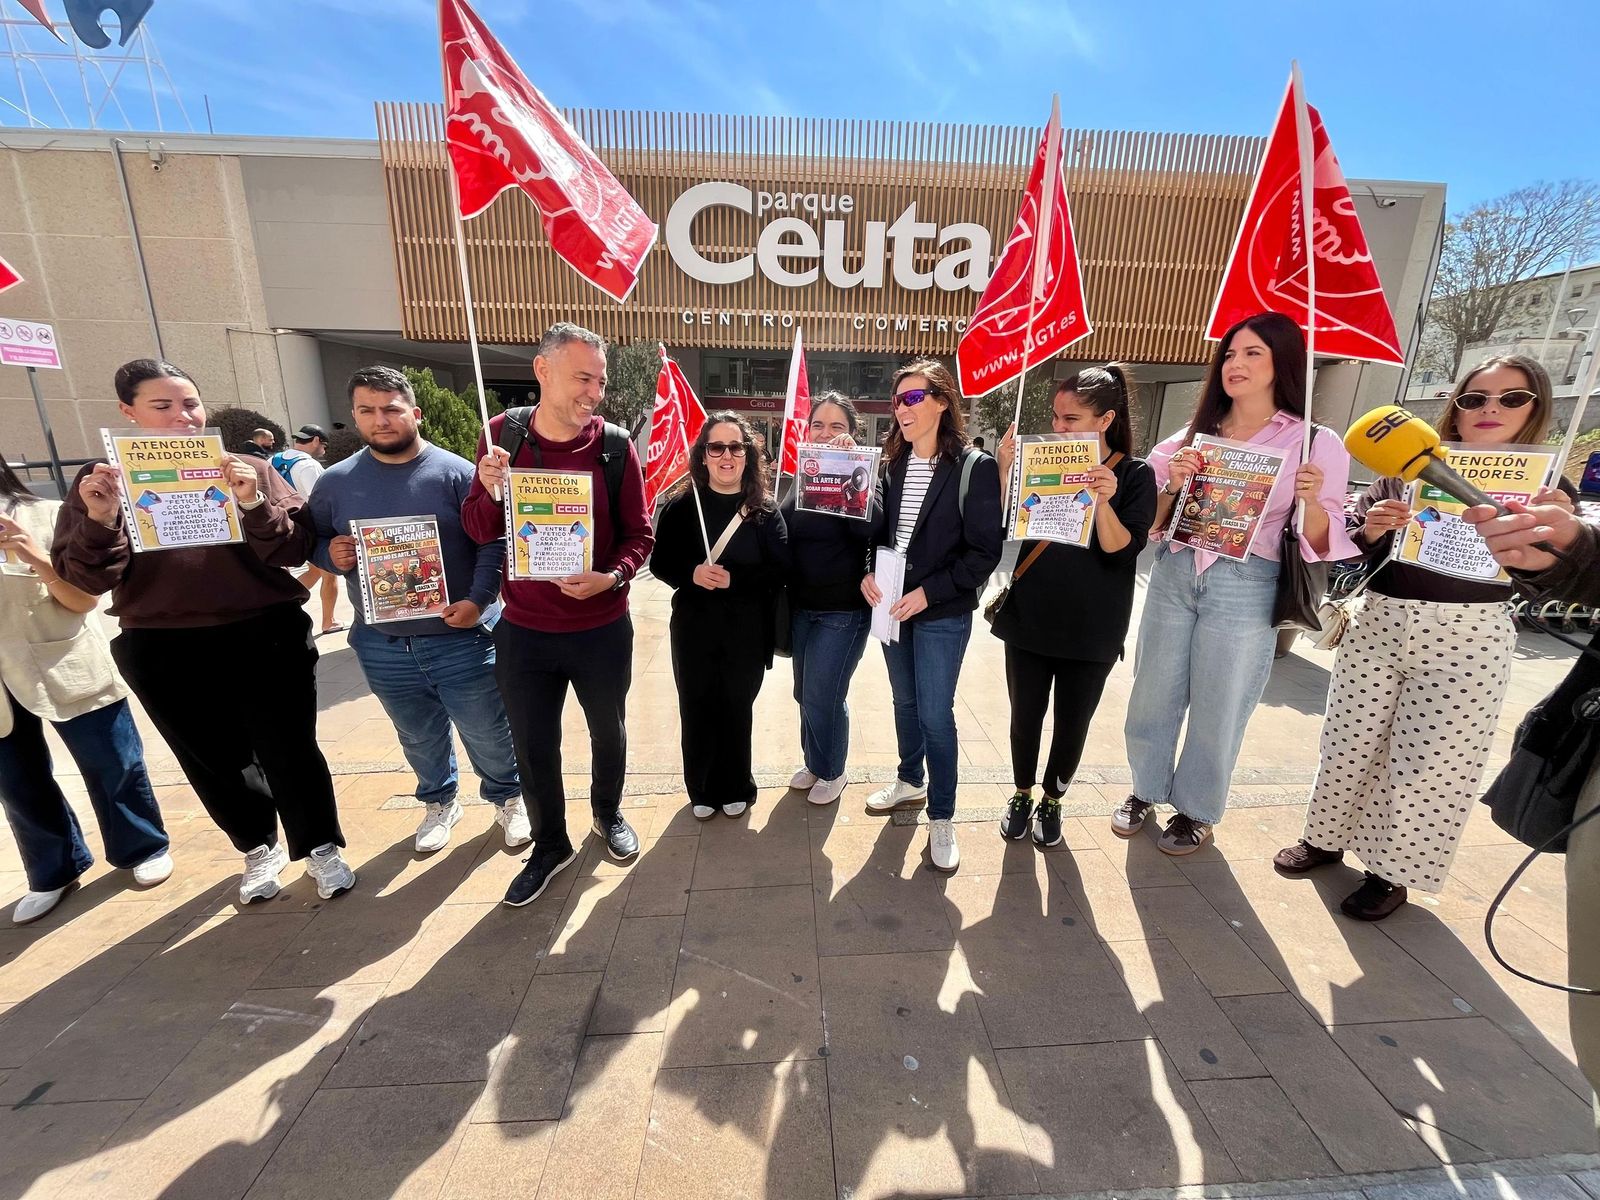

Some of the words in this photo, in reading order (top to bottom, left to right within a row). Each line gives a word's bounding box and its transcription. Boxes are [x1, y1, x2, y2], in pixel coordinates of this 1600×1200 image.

[758, 191, 854, 219] parque
[665, 181, 991, 292] Ceuta
[682, 311, 793, 327] CENTRO
[853, 316, 967, 333] COMERC
[750, 400, 776, 408] Ceuta
[131, 438, 206, 450] ATENCIÓN
[1034, 442, 1089, 454] ATENCIÓN
[126, 450, 214, 461] TRAIDORES.
[1028, 455, 1093, 465] TRAIDORES.
[1221, 451, 1244, 460] ¡QUE
[1244, 453, 1258, 463] NO
[1258, 456, 1270, 464] TE
[1450, 454, 1528, 467] TENCIÓN
[184, 470, 221, 478] CCOO
[1216, 469, 1247, 479] CONVENIO
[1461, 469, 1529, 480] IDORES.
[522, 476, 578, 486] ATENCIÓN
[517, 486, 583, 495] TRAIDORES.
[1491, 494, 1527, 505] COO
[384, 526, 402, 538] ¡QUE
[404, 524, 415, 534] NO
[1444, 521, 1475, 531] "FETIC
[1434, 530, 1457, 540] CAMA
[388, 542, 414, 552] CONVENIO
[1430, 541, 1476, 555] FIRMANDO
[1442, 556, 1460, 564] NOS
[1463, 560, 1492, 568] QUITA
